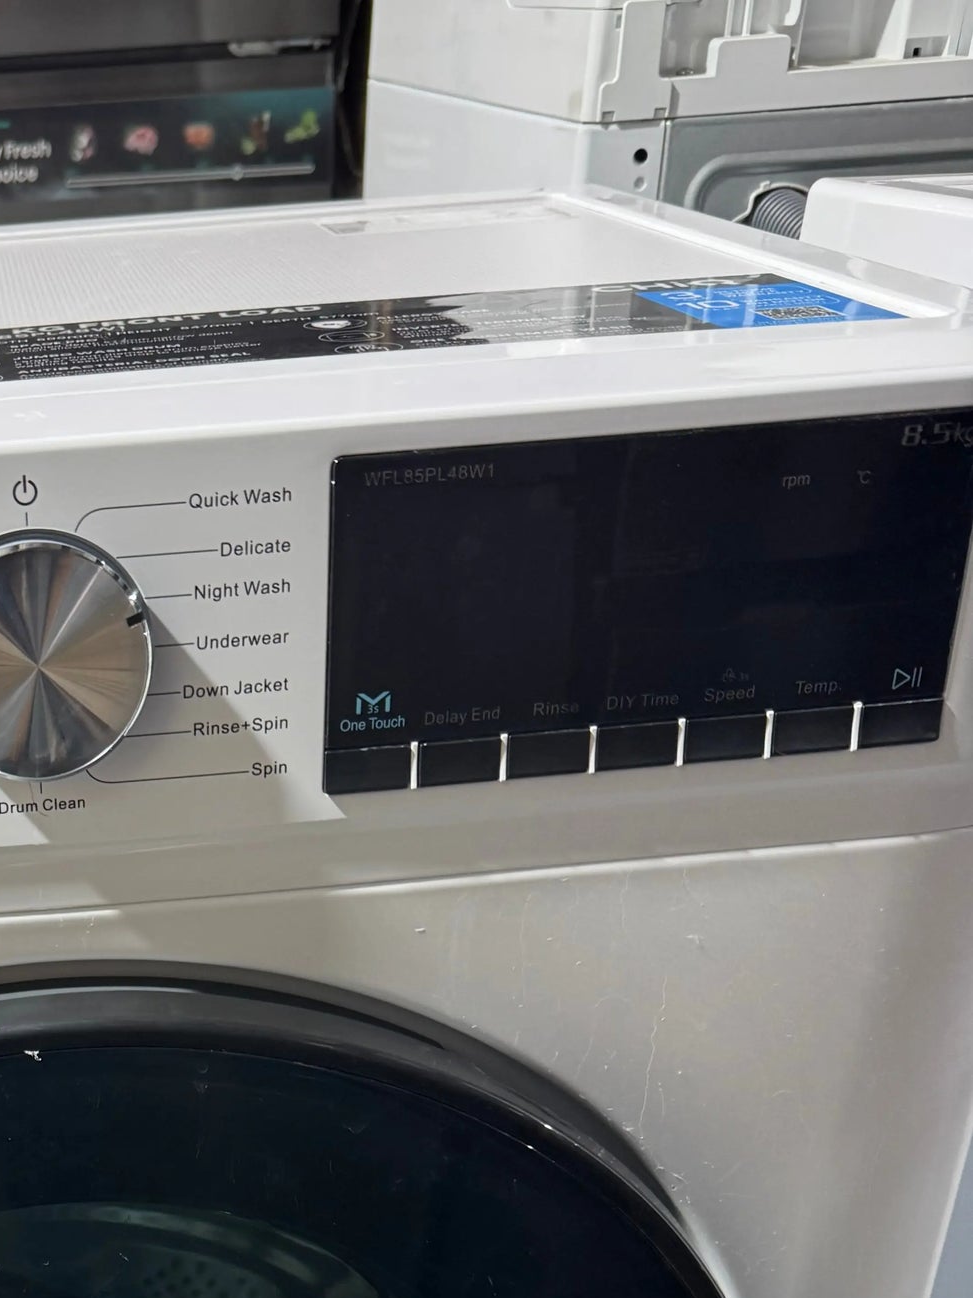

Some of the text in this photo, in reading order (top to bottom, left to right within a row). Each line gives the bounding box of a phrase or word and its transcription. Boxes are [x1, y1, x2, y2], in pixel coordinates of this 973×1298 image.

[79, 314, 205, 328] FRONT
[218, 305, 320, 318] LOAD
[364, 464, 496, 488] WFL85PL48W1
[782, 473, 811, 489] rpm
[188, 487, 293, 511] Quick Wash
[219, 538, 292, 558] Delicate
[193, 579, 292, 604] Night Wash
[196, 630, 290, 651] Underwear
[182, 678, 289, 700] Down Jacket
[703, 684, 756, 703] Speed
[796, 679, 842, 695] Temp.
[368, 704, 379, 714] 3s
[533, 702, 580, 717] Rinse
[606, 692, 680, 711] DIY Time
[192, 715, 289, 737] Rinse+Spin
[339, 715, 406, 733] One Touch
[424, 706, 501, 726] Delay End
[251, 760, 288, 780] Spin
[41, 796, 86, 813] Clean
